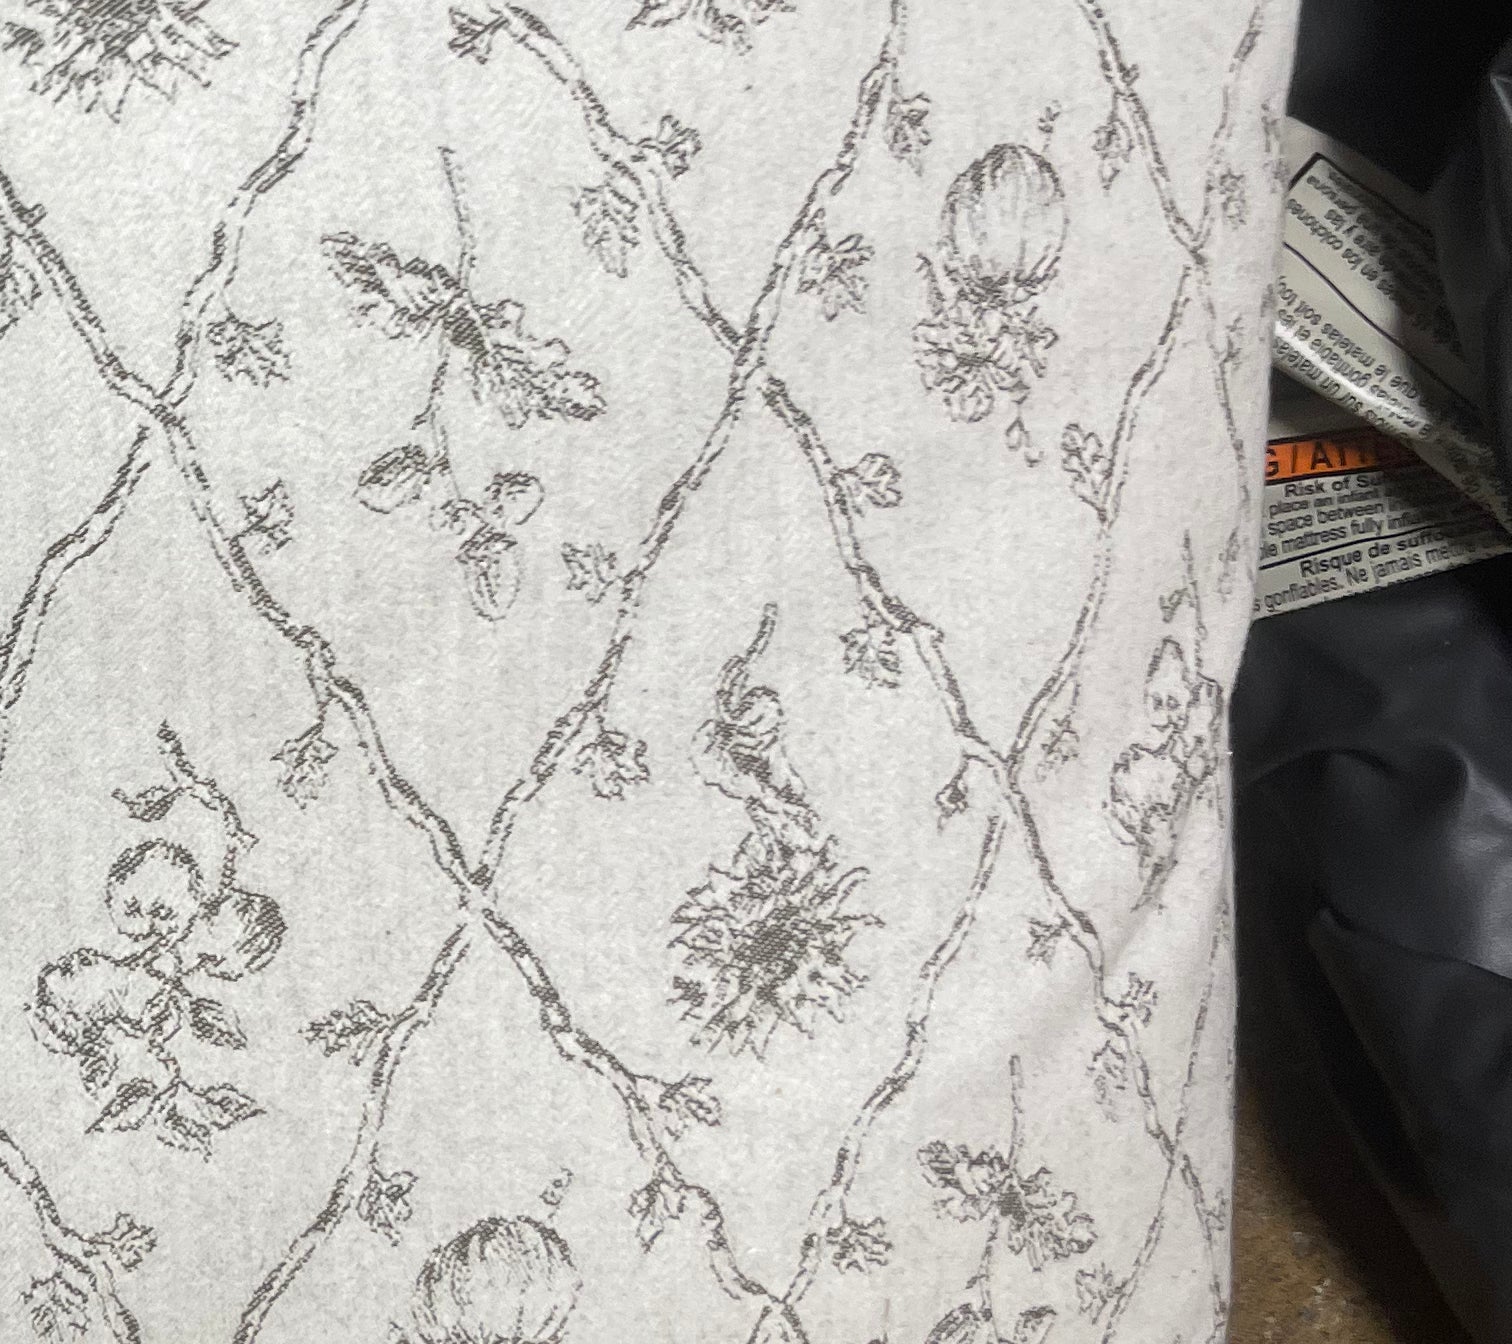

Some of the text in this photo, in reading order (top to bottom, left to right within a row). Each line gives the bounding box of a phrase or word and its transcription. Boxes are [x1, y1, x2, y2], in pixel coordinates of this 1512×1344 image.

[1287, 198, 1344, 250] colchones
[1341, 248, 1365, 271] los
[1321, 323, 1375, 367] matelas
[1320, 376, 1341, 396] un
[1338, 392, 1363, 412] sur
[1284, 480, 1326, 497] Risk
[1331, 475, 1351, 491] of
[1268, 503, 1384, 537] space between
[1269, 500, 1310, 519] place
[1282, 526, 1347, 554] mattress
[1350, 517, 1384, 536] fully
[1300, 549, 1363, 578] Risque
[1368, 542, 1391, 559] de
[1346, 567, 1369, 586] Ne
[1371, 554, 1423, 584] jamais
